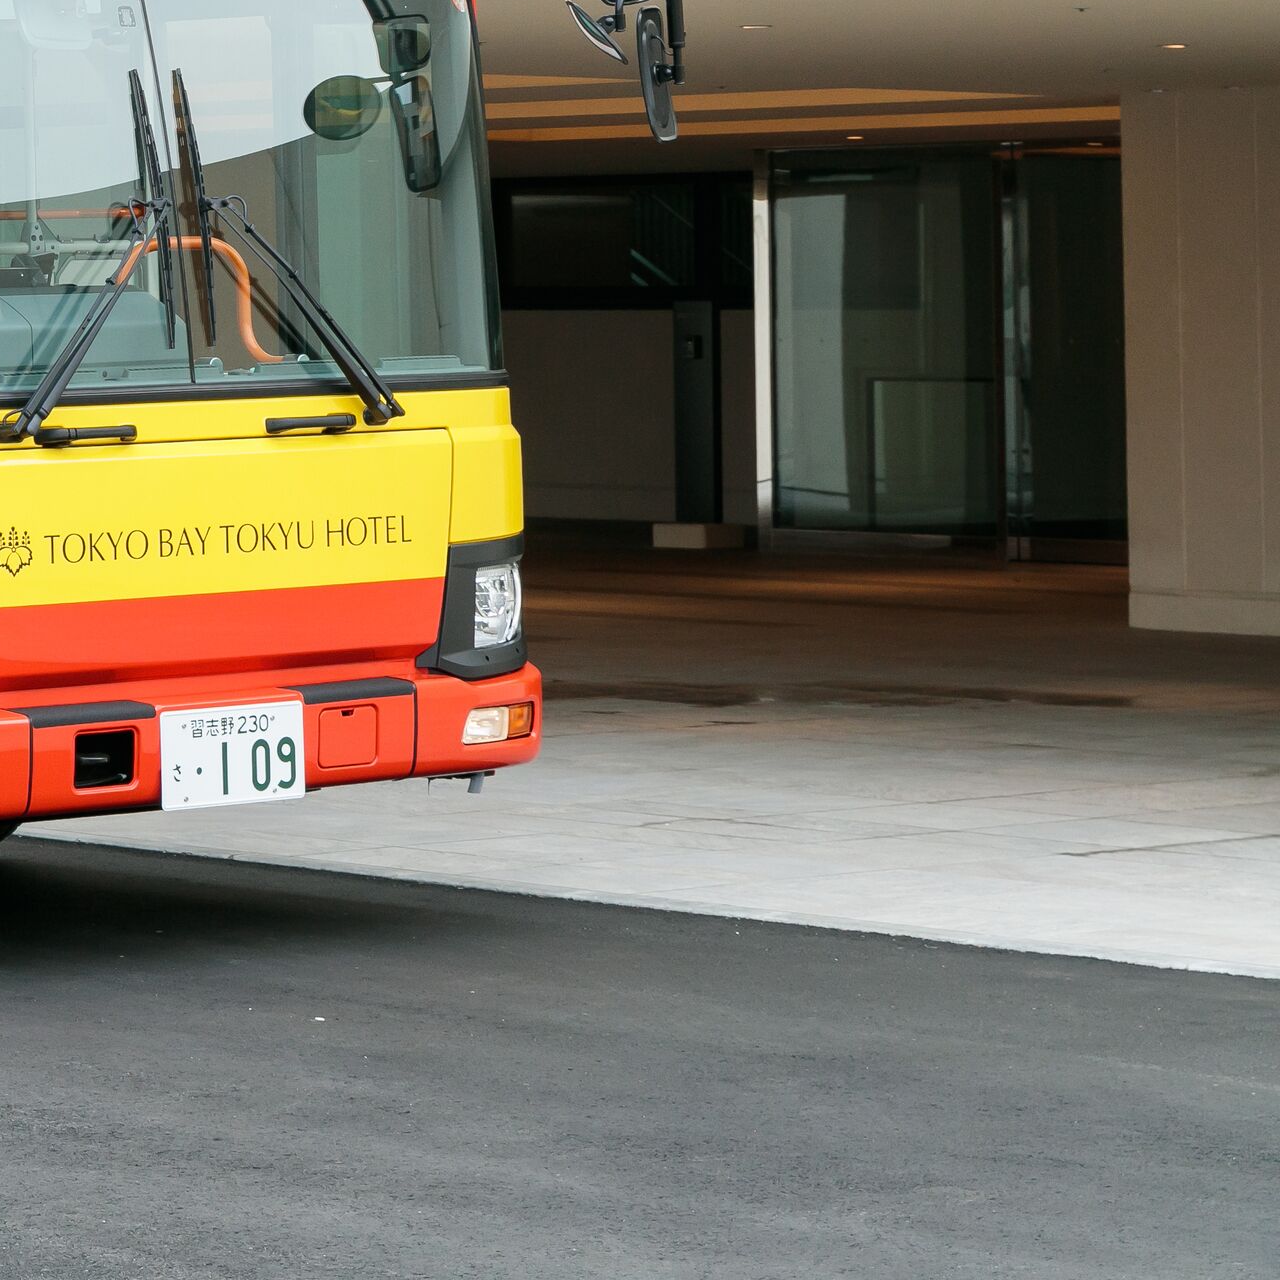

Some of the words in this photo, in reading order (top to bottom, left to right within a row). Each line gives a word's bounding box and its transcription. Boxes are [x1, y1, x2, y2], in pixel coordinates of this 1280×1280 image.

[44, 530, 148, 563] TOKYO
[160, 527, 210, 557] BAY
[220, 521, 314, 553] TOKYU
[327, 515, 411, 547] HOTEL
